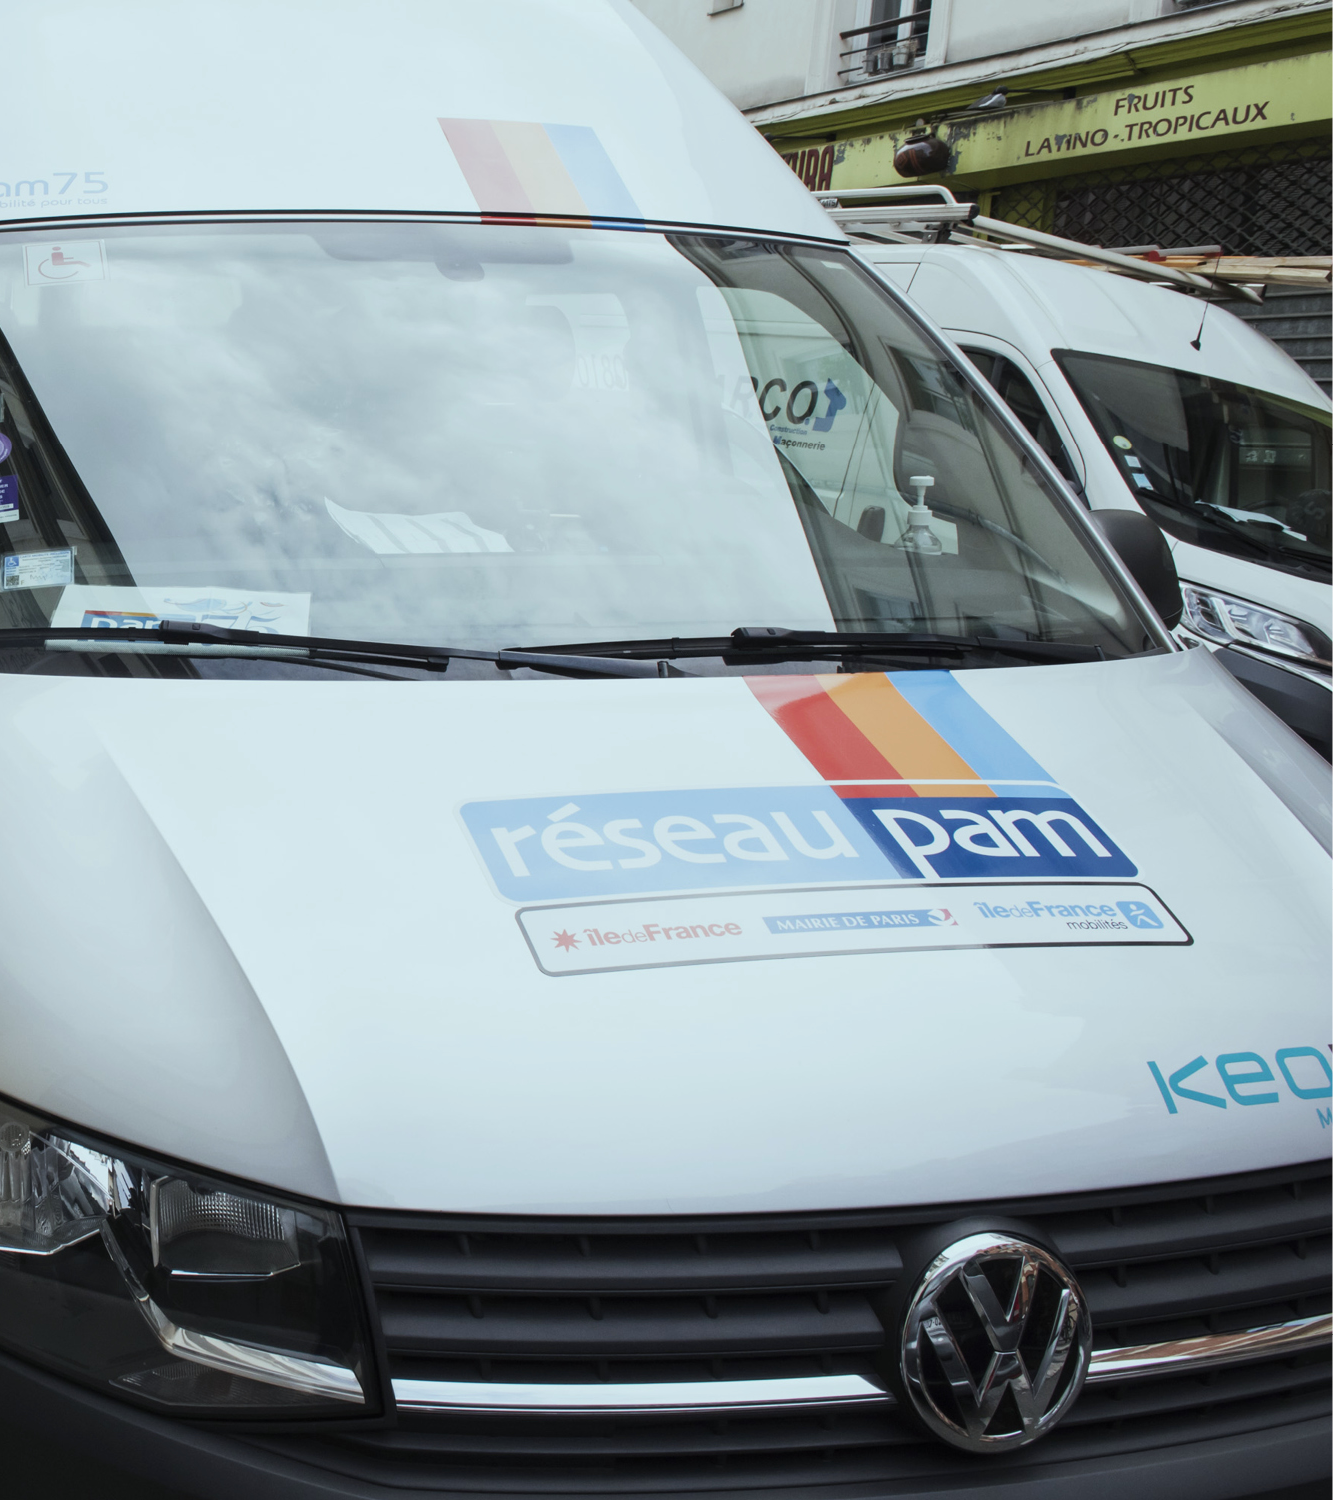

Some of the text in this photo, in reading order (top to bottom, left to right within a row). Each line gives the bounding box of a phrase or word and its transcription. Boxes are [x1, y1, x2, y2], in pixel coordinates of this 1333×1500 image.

[1113, 85, 1195, 116] FRUITS
[1124, 101, 1270, 142] TROPICAUX
[41, 198, 72, 208] pour
[77, 197, 107, 205] tous
[769, 424, 807, 435] Construction
[490, 802, 1113, 878] réseau pam
[776, 913, 920, 931] MAIRIE DE PARIS
[1066, 919, 1128, 929] mobilités
